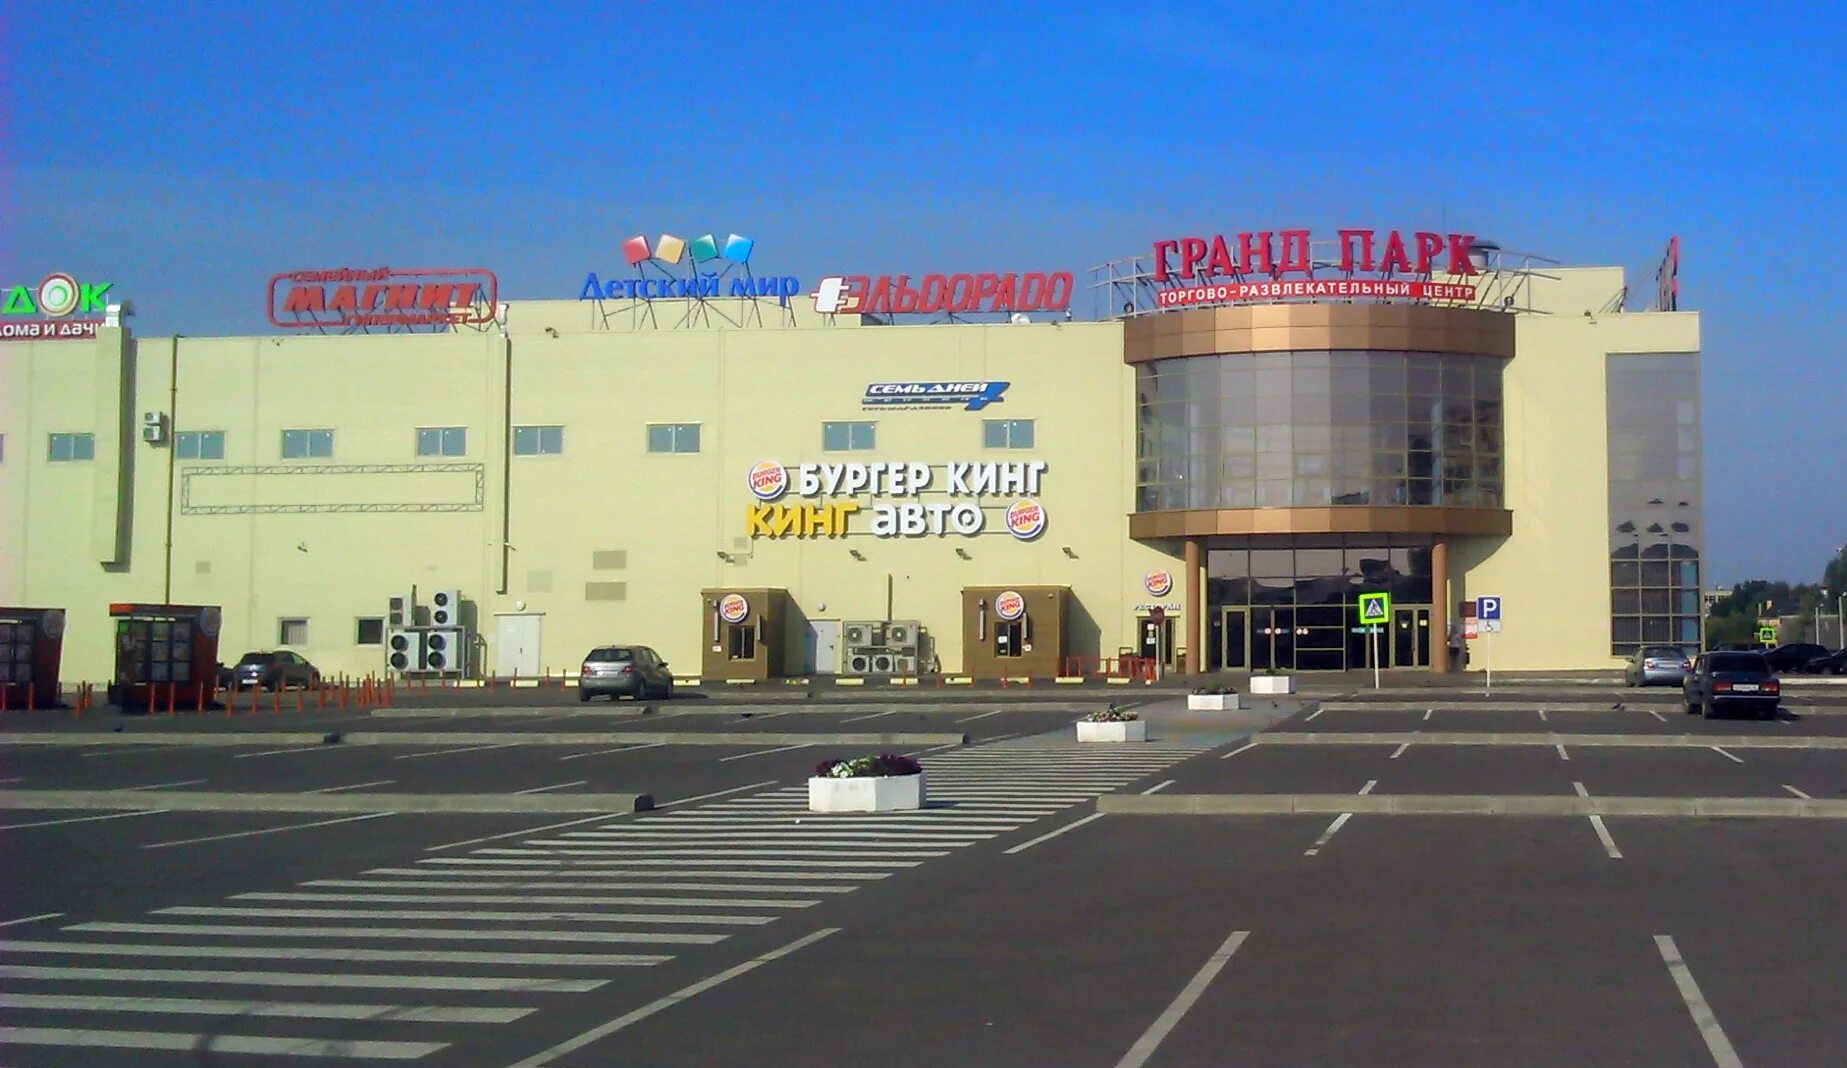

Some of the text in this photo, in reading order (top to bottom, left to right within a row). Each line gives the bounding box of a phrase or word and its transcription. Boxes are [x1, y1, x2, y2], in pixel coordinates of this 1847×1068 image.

[1153, 229, 1478, 282] ГРАНД ПАРК
[283, 283, 481, 312] МАГНИТ
[579, 272, 800, 307] Детский мир
[1160, 281, 1474, 303] ТОРГОВО-РАЗВЛЕКАТЕЛЬНЫЙ ЦЕНТР
[0, 323, 40, 337] ома
[870, 384, 926, 394] СЕМЬ
[752, 474, 782, 490] KING
[800, 461, 1046, 496] БУРГЕР КИНГ
[1009, 505, 1039, 519] BURGER
[1010, 512, 1040, 527] KING
[1483, 599, 1498, 618] P
